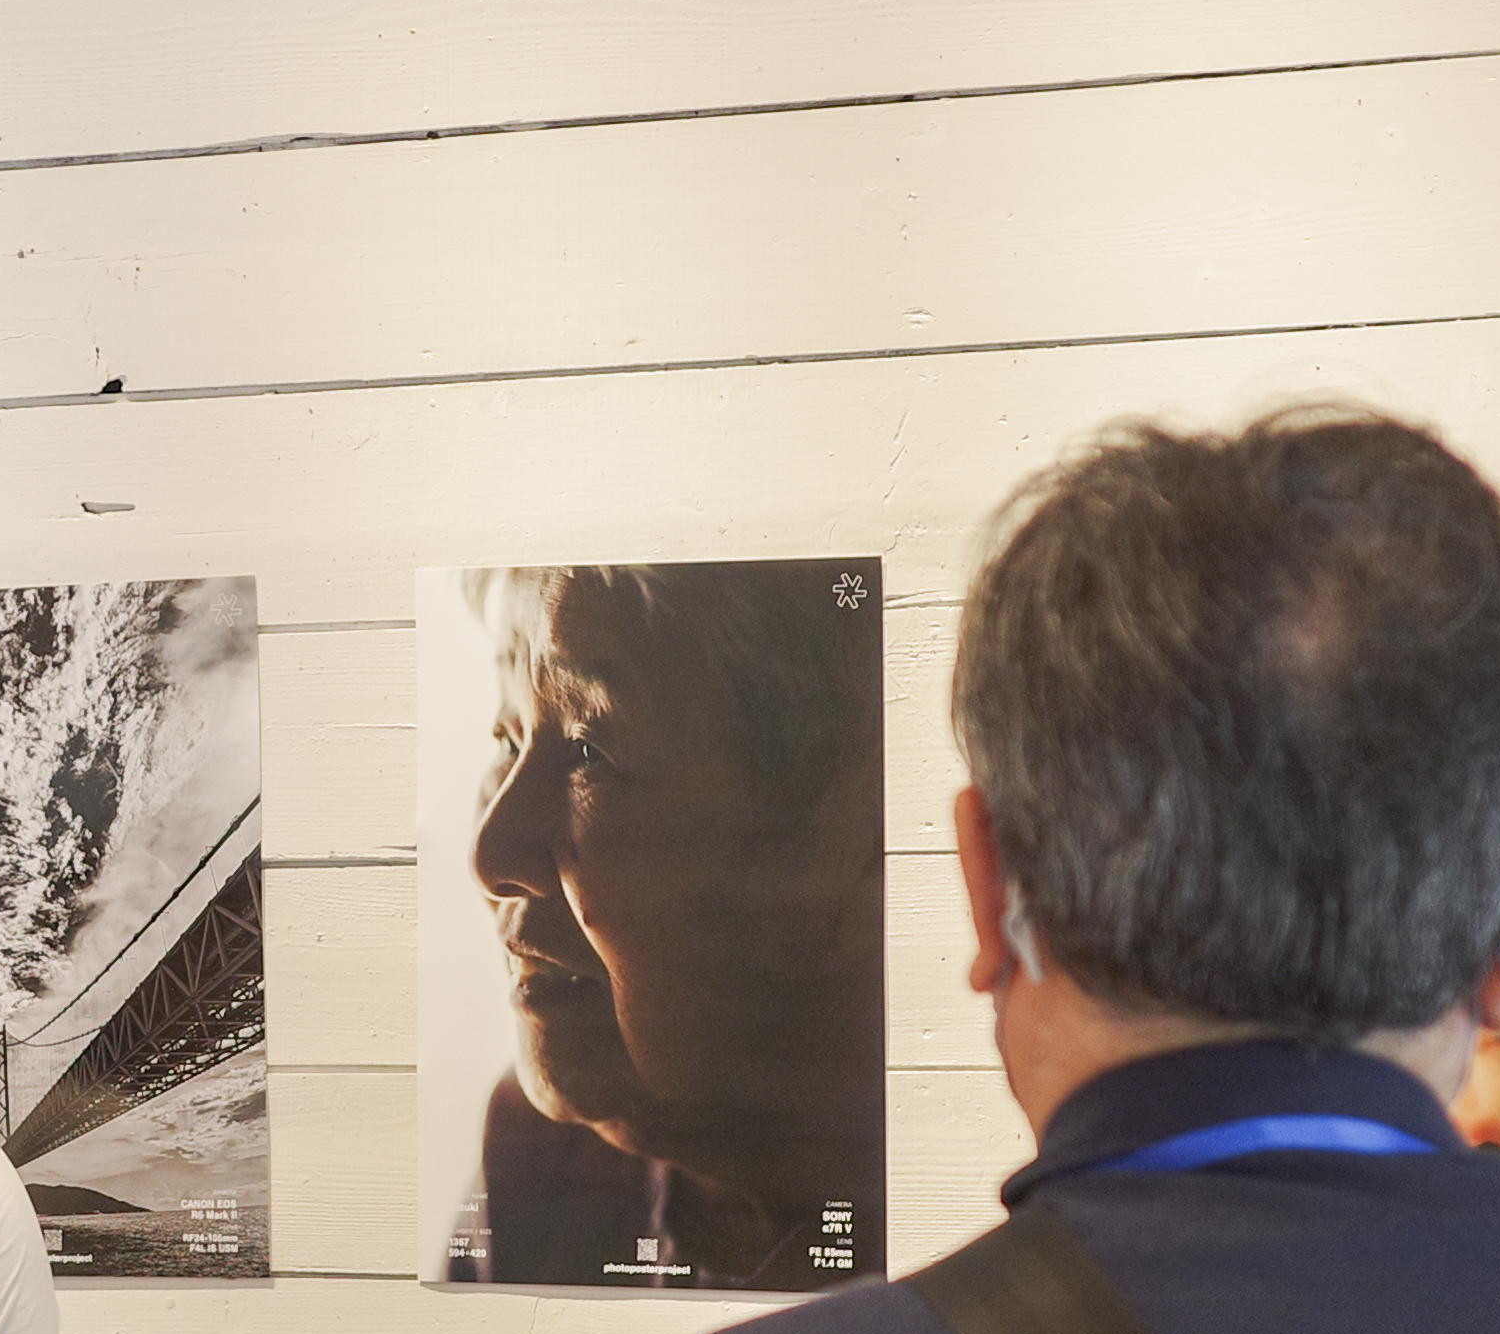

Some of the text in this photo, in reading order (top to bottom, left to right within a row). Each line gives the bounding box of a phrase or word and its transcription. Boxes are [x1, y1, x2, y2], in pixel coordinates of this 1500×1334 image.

[180, 1199, 237, 1209] CANON EOS
[190, 1210, 205, 1220] R6
[206, 1210, 230, 1220] Mark
[822, 1210, 853, 1222] SONY
[844, 1223, 853, 1234] V
[218, 1243, 239, 1253] USM
[603, 1262, 691, 1276] photoposterproject
